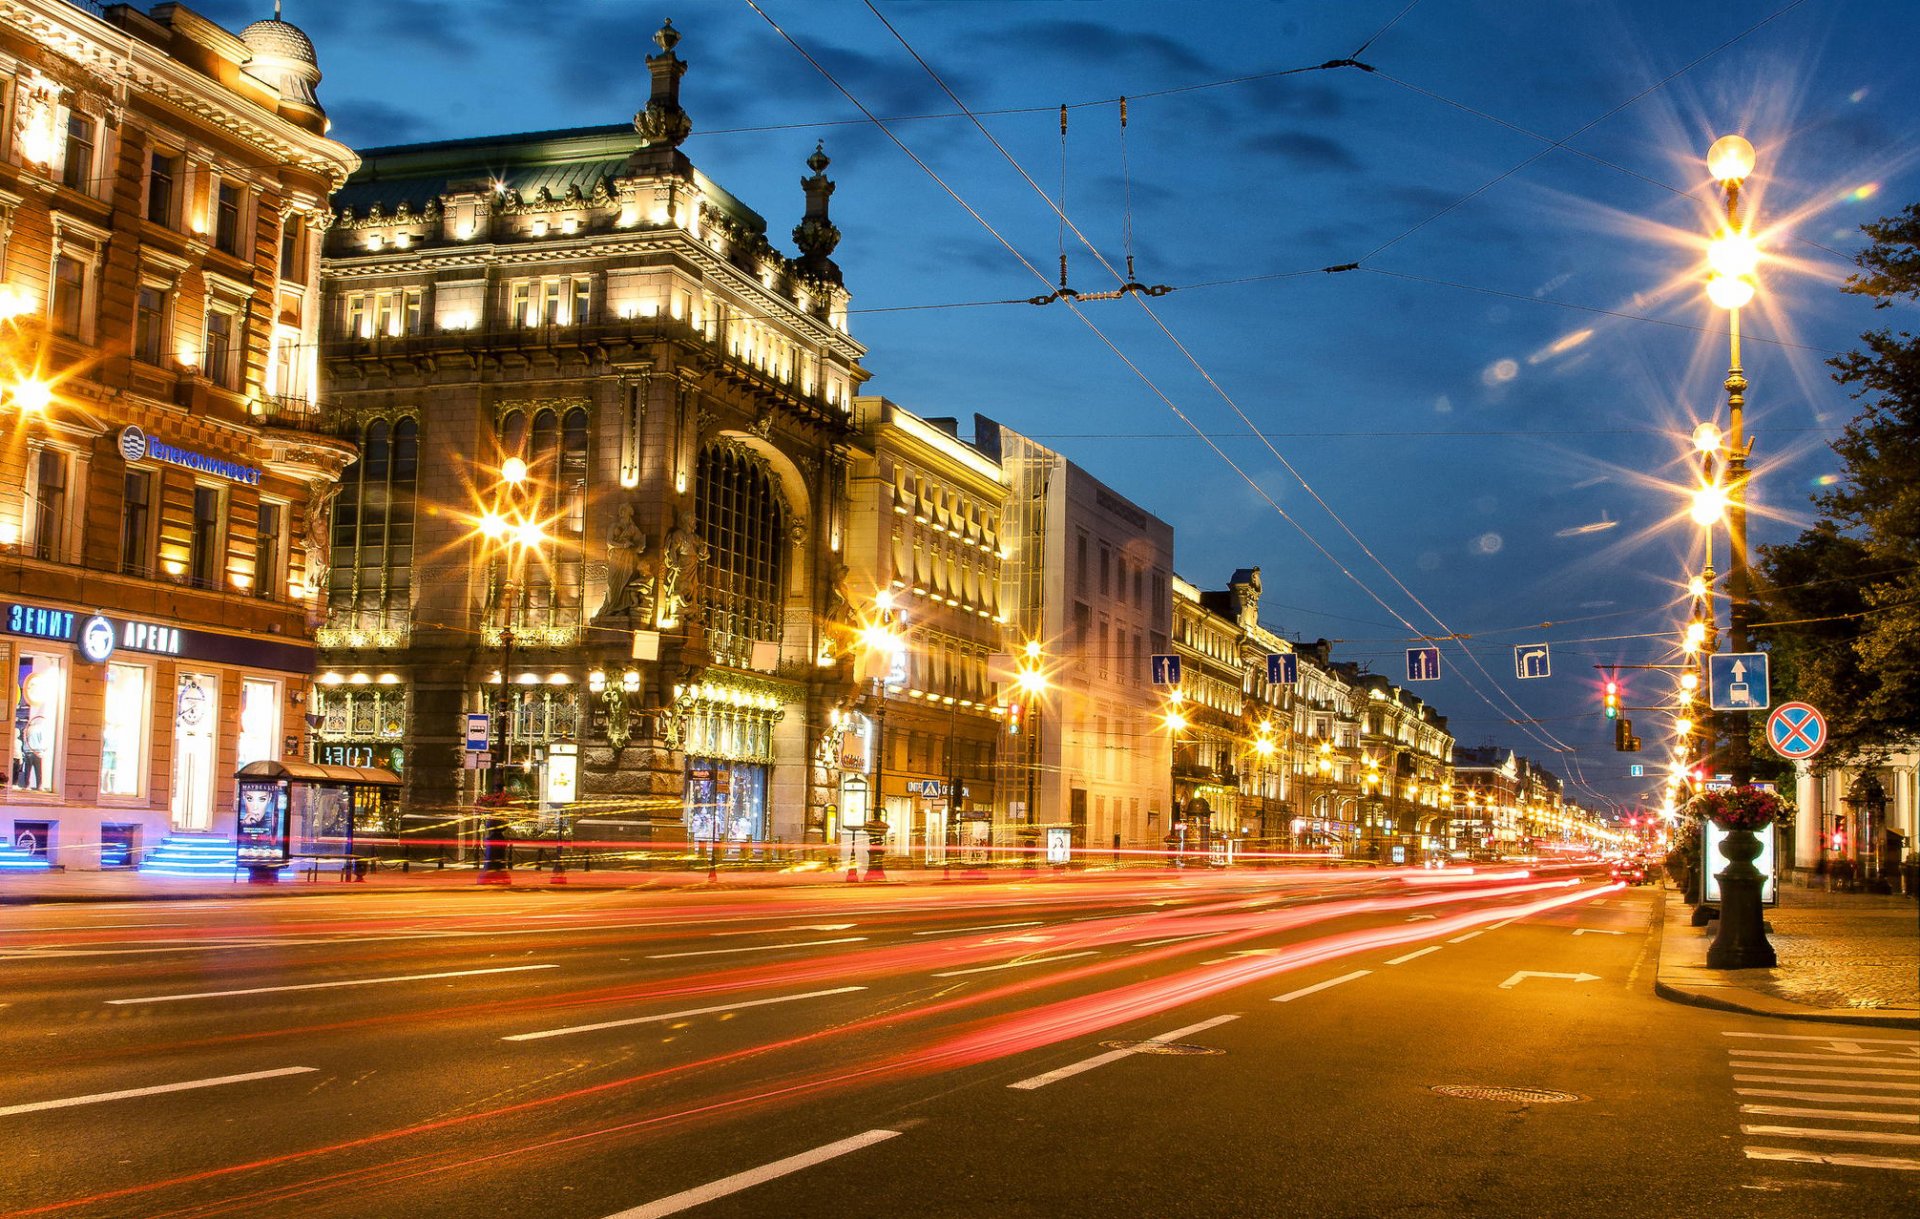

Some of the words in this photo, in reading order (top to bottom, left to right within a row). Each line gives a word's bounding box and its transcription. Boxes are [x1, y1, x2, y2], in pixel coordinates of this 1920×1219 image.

[146, 434, 262, 486] Телекоминвест
[10, 604, 74, 639] ЗЕНИТ
[123, 621, 179, 654] АРЕНА
